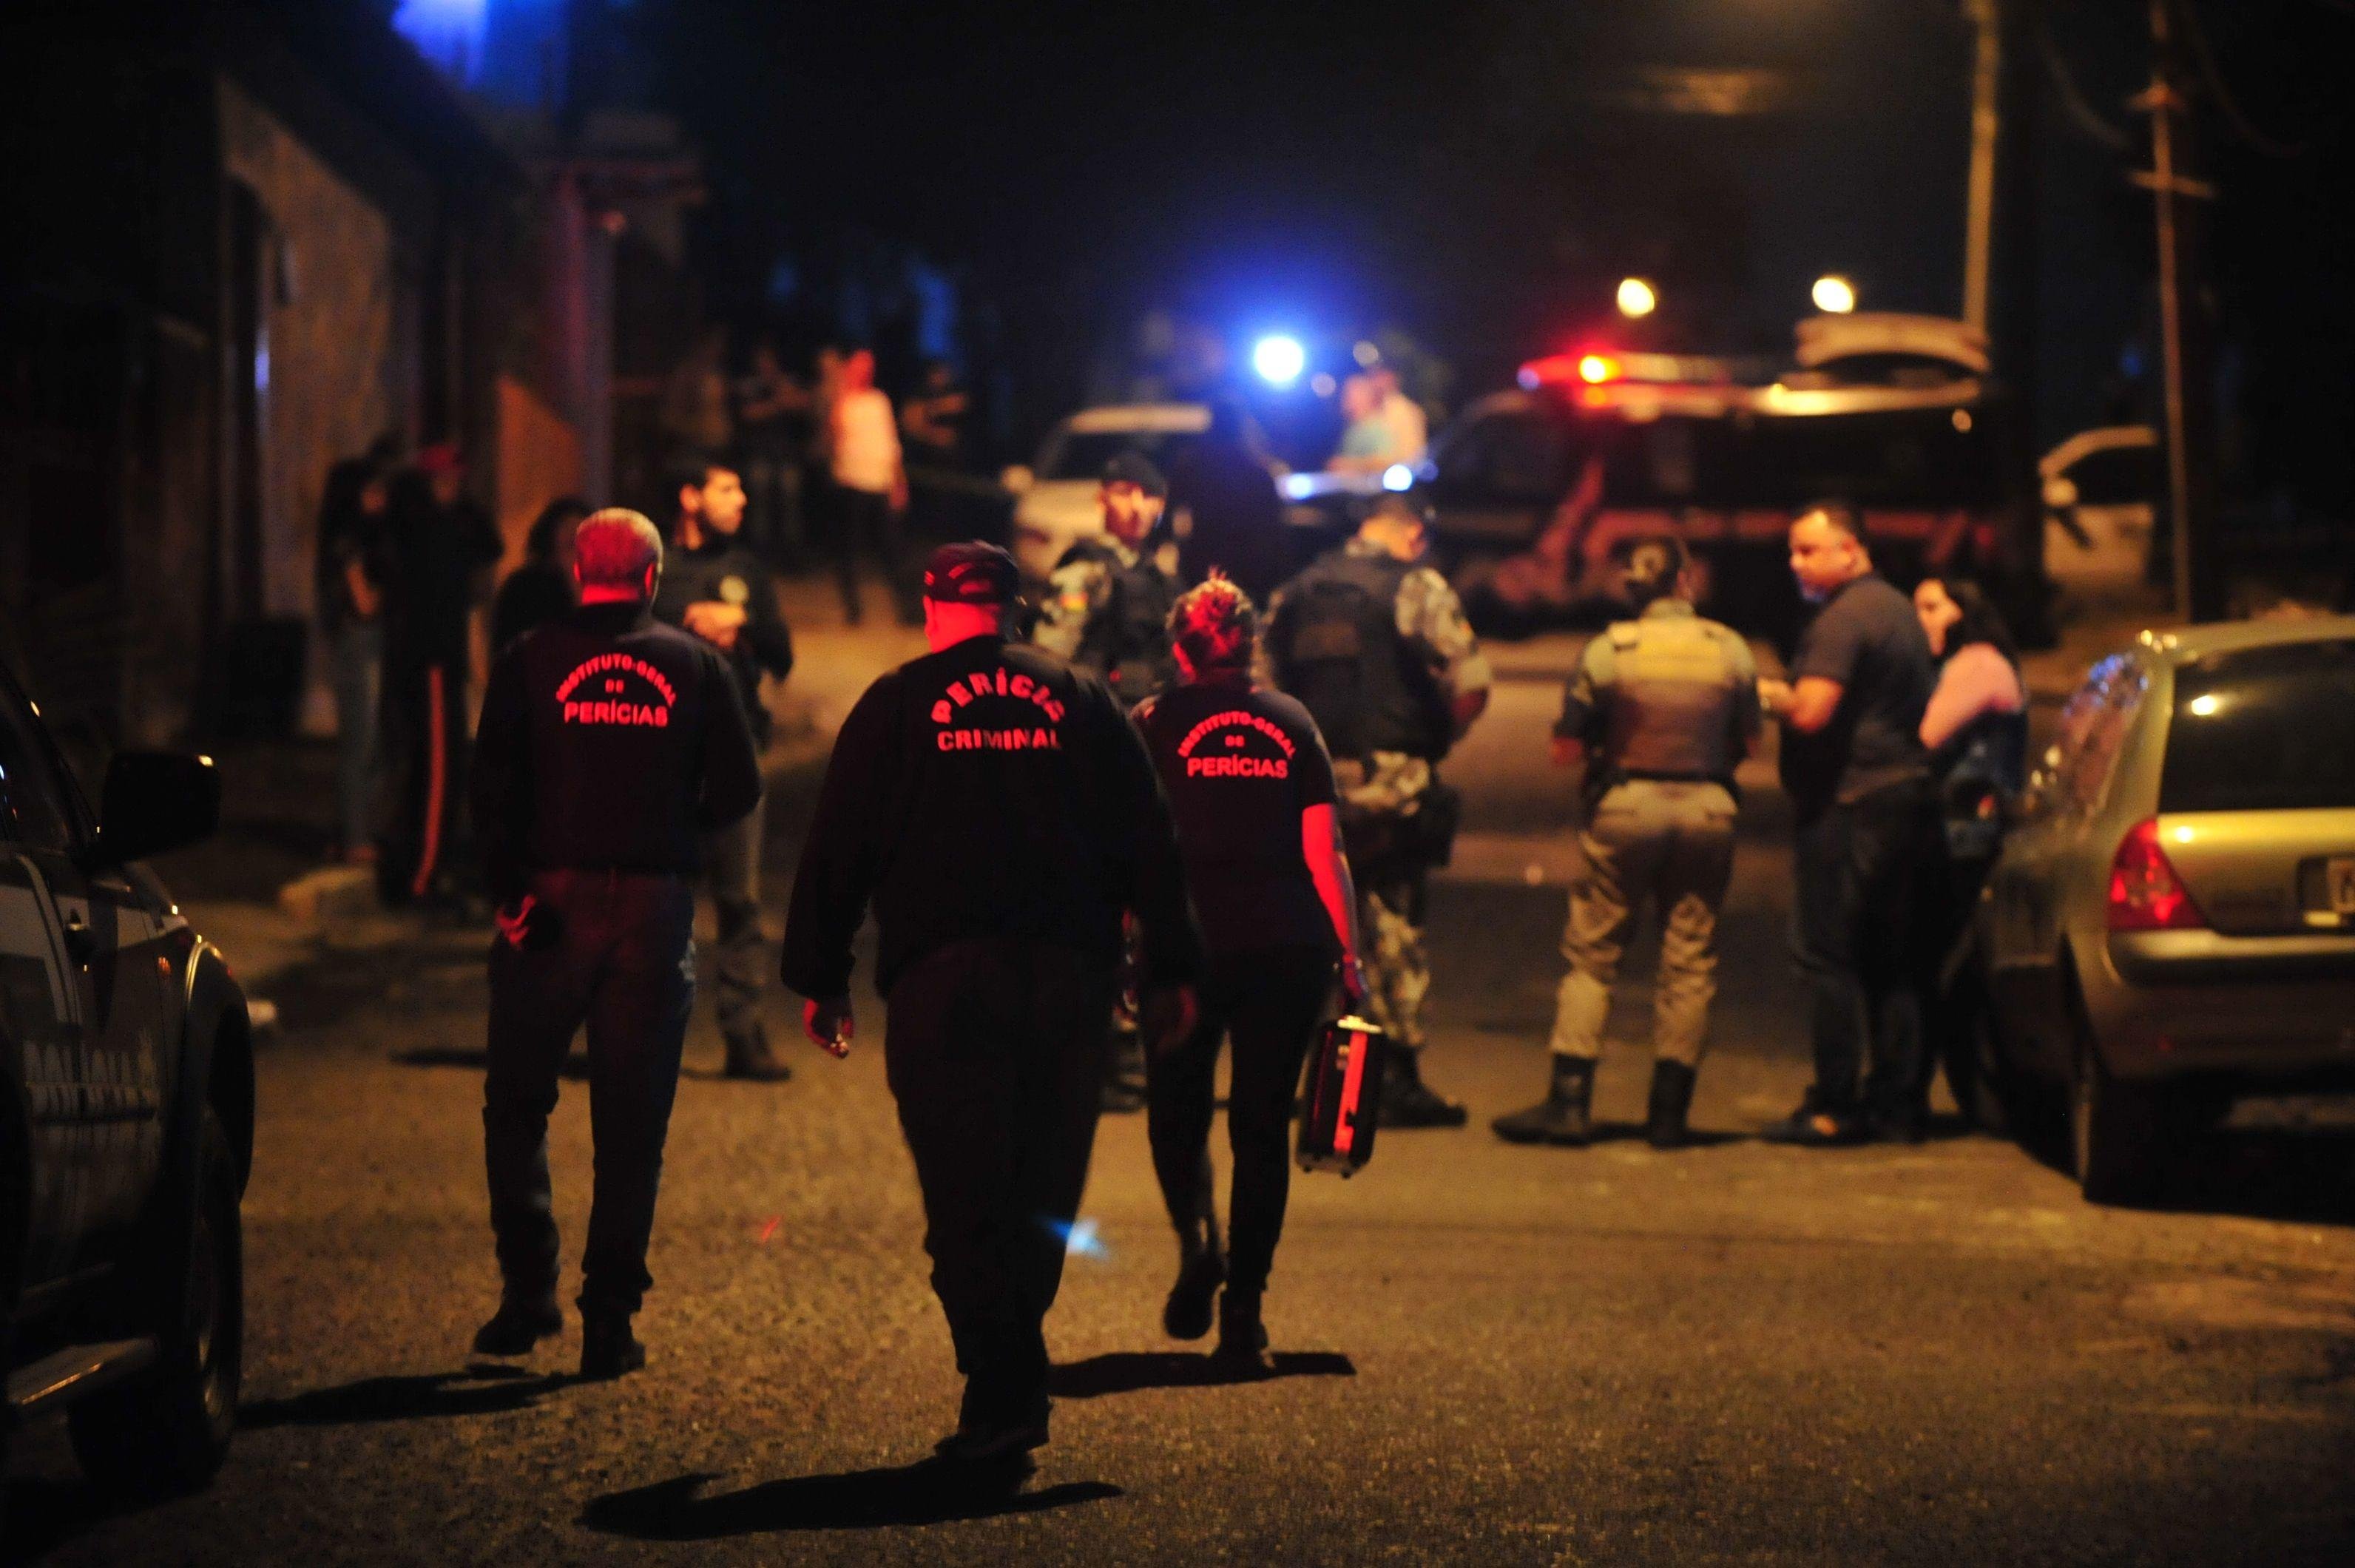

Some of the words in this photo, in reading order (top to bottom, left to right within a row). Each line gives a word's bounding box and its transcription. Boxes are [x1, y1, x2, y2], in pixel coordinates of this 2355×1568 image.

[564, 699, 668, 727] PERÍCIAS
[937, 728, 1061, 751] CRIMINAL
[1187, 754, 1288, 779] PERÍCIAS
